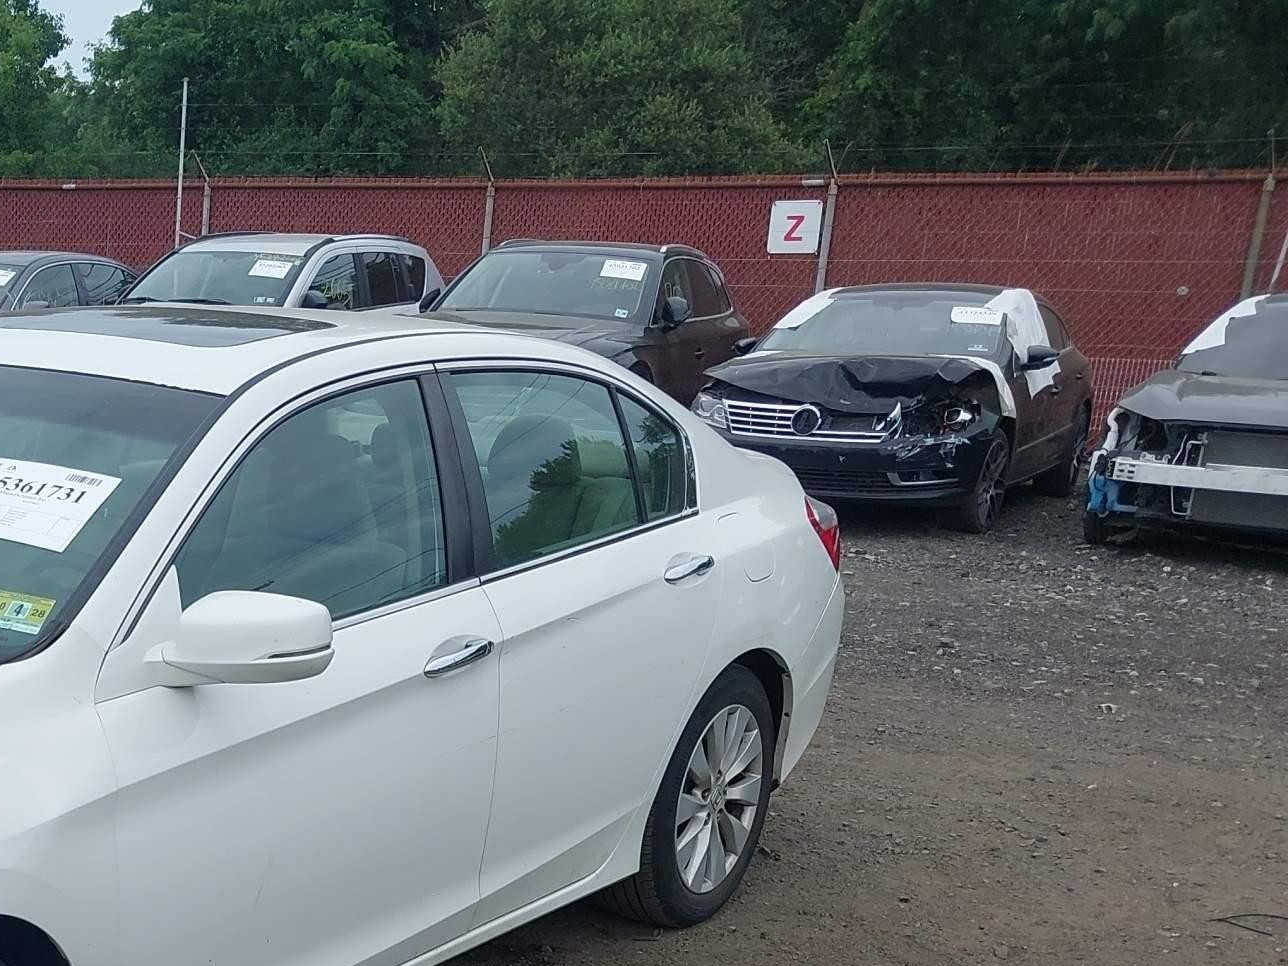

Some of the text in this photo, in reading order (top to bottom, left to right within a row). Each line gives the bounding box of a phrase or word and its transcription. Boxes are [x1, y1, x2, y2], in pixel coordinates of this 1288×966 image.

[783, 215, 805, 241] Z
[14, 603, 25, 617] 4
[30, 608, 46, 618] 28
